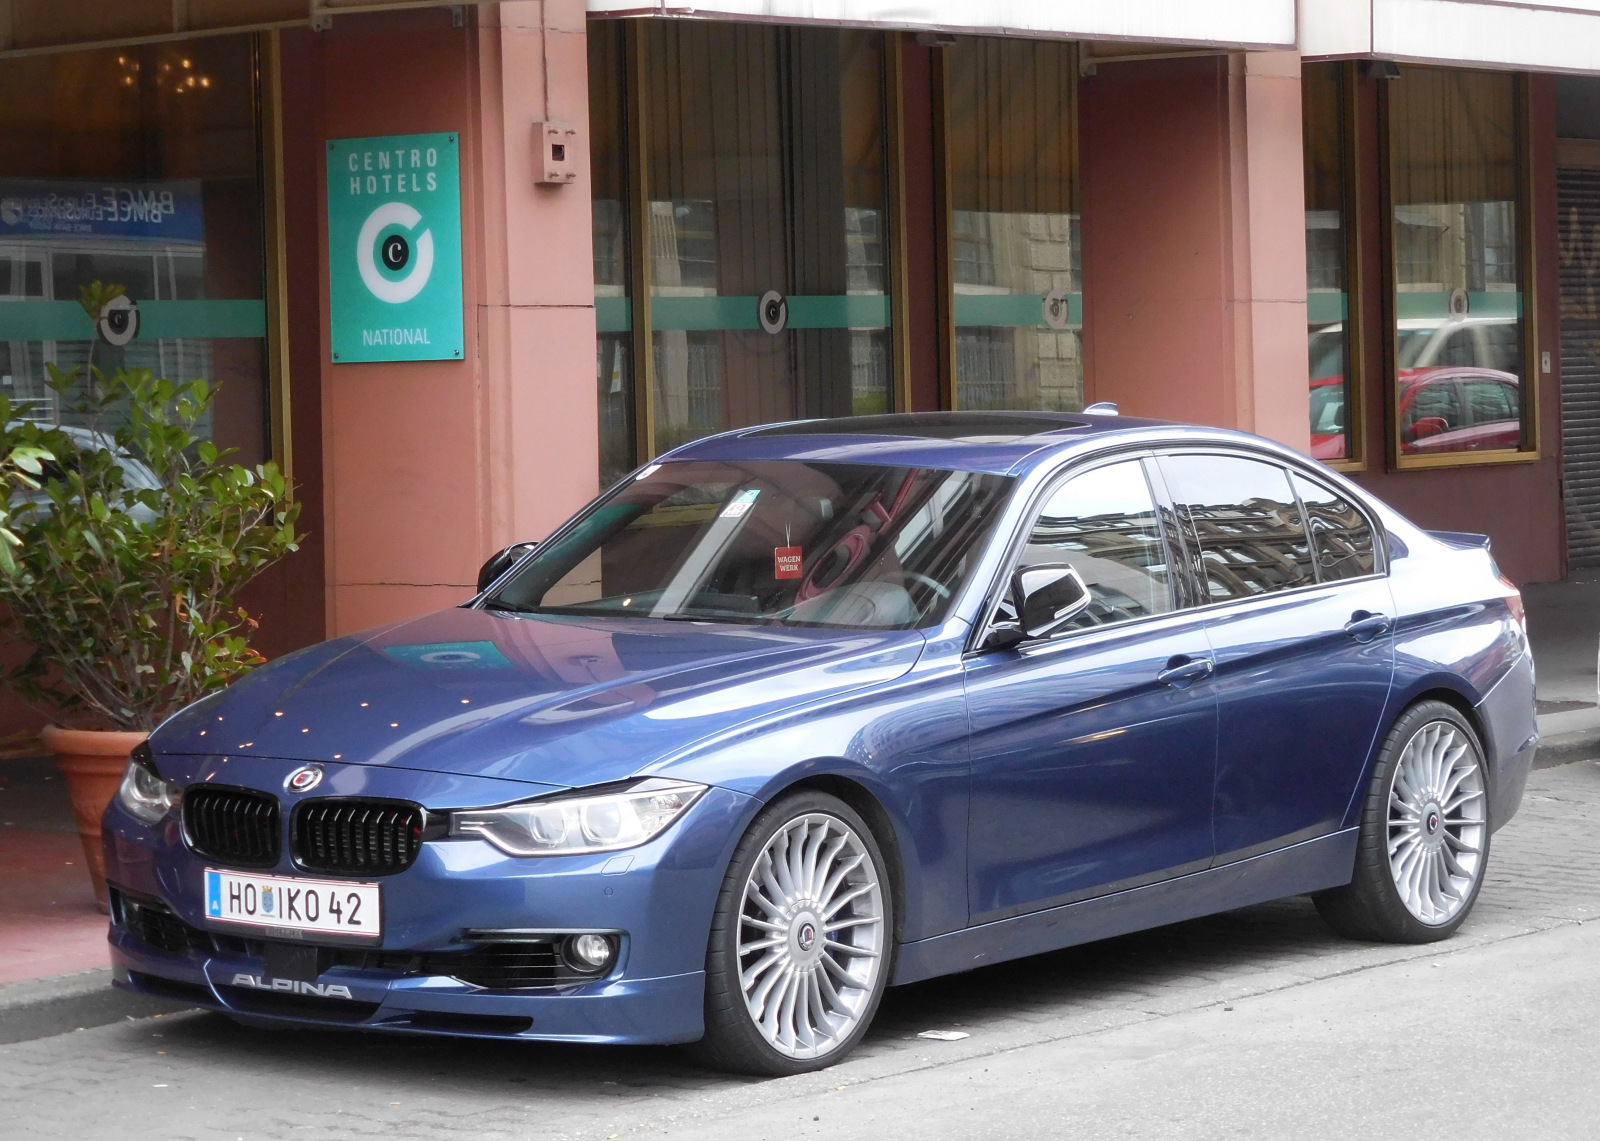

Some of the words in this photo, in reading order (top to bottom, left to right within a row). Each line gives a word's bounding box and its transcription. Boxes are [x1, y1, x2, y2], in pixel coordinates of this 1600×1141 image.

[348, 147, 437, 172] CENTRO
[349, 172, 437, 196] HOTELS
[388, 242, 403, 263] C
[362, 327, 431, 346] NATIONAL
[777, 555, 801, 563] WAGEN
[780, 564, 799, 572] WERK
[211, 901, 219, 911] A
[229, 881, 257, 916] HO
[328, 891, 362, 926] 42
[231, 973, 353, 999] ALPINA
